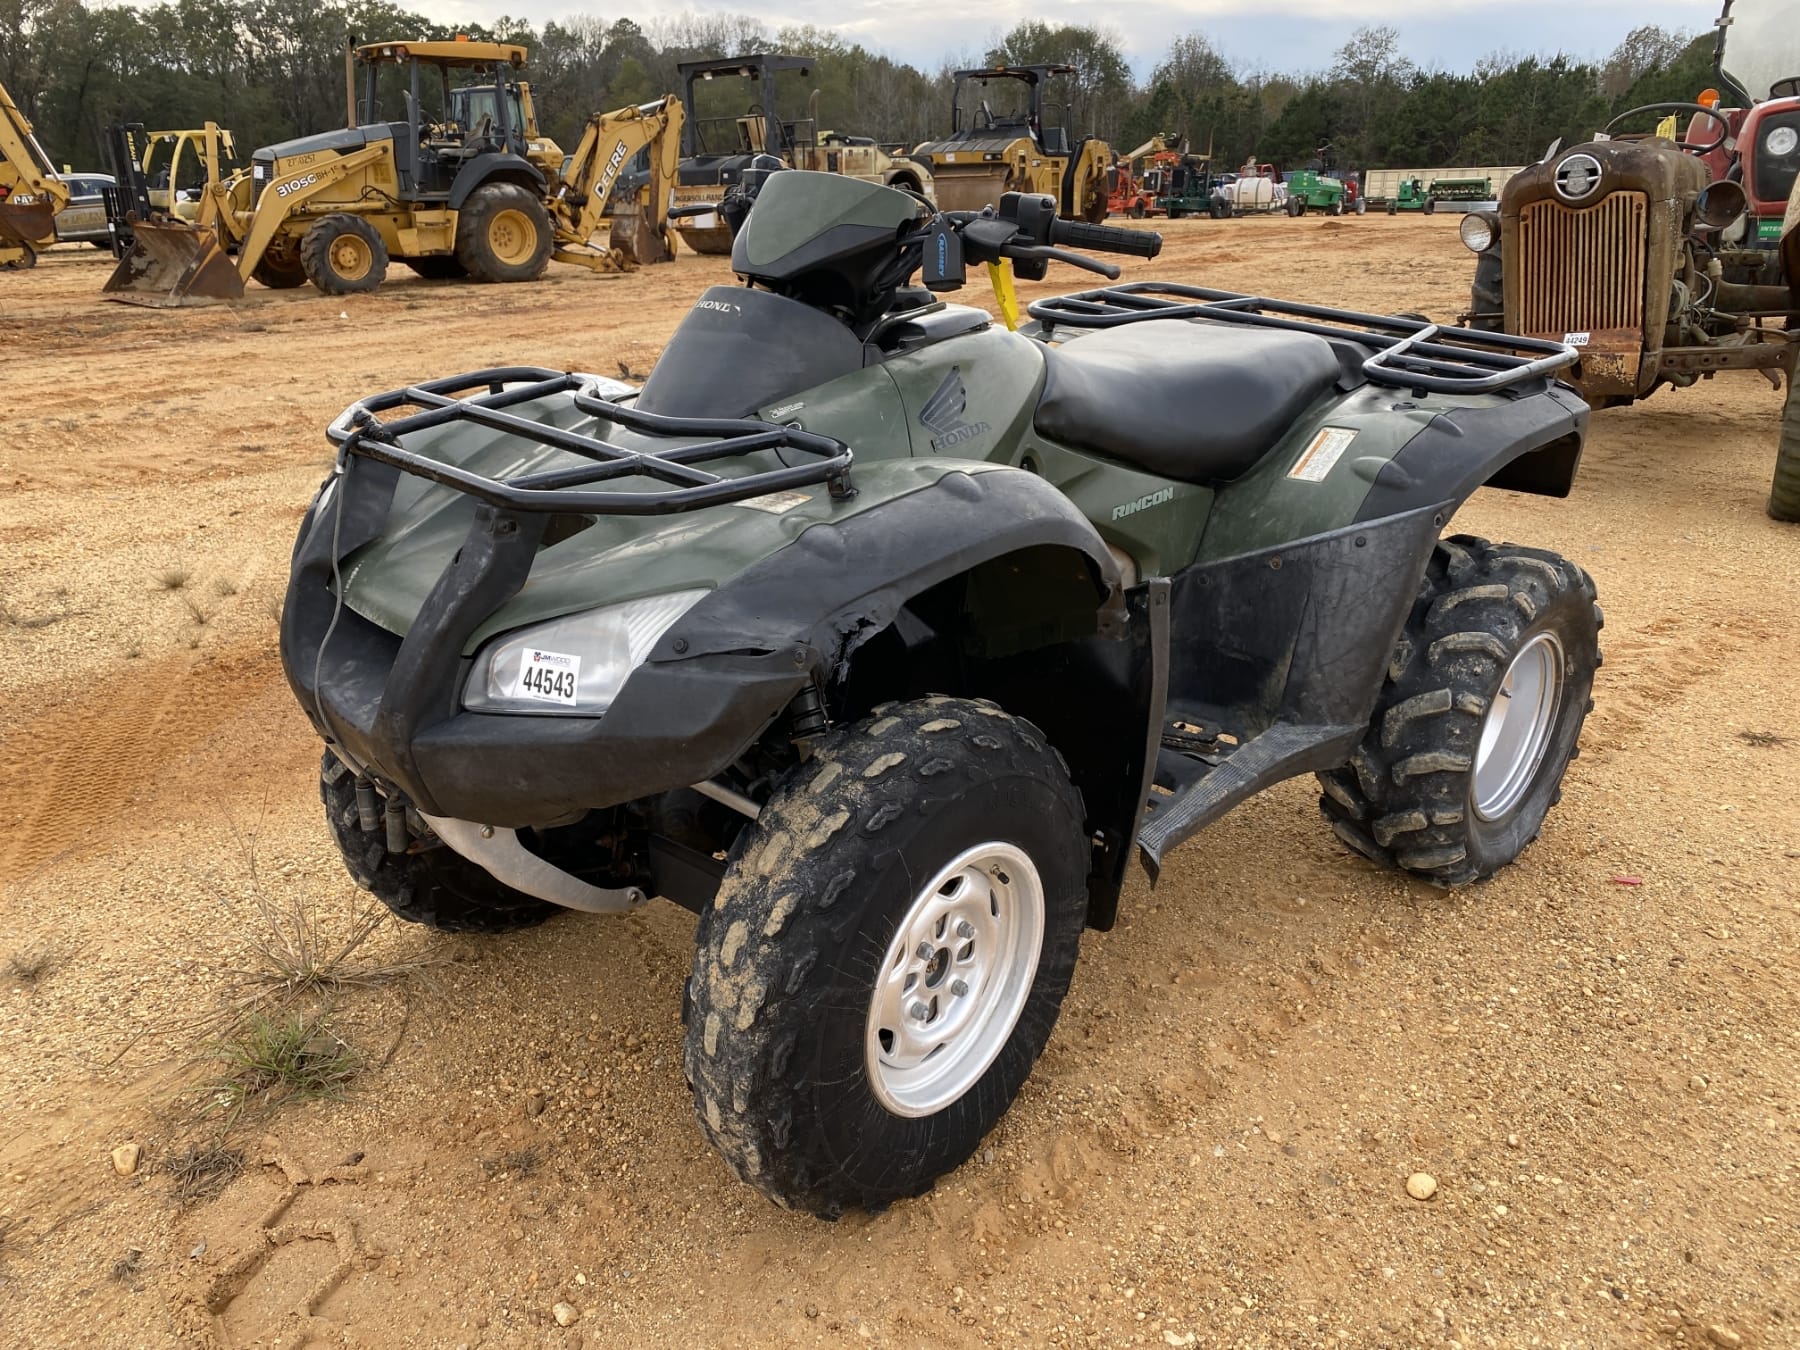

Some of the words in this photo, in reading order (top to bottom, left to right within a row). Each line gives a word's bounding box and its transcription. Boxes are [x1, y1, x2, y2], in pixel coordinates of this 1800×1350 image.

[276, 173, 318, 198] 310SG
[593, 139, 628, 200] DEERE
[931, 421, 992, 453] HONDA
[1112, 486, 1174, 520] RINCON
[522, 666, 575, 699] 44543
